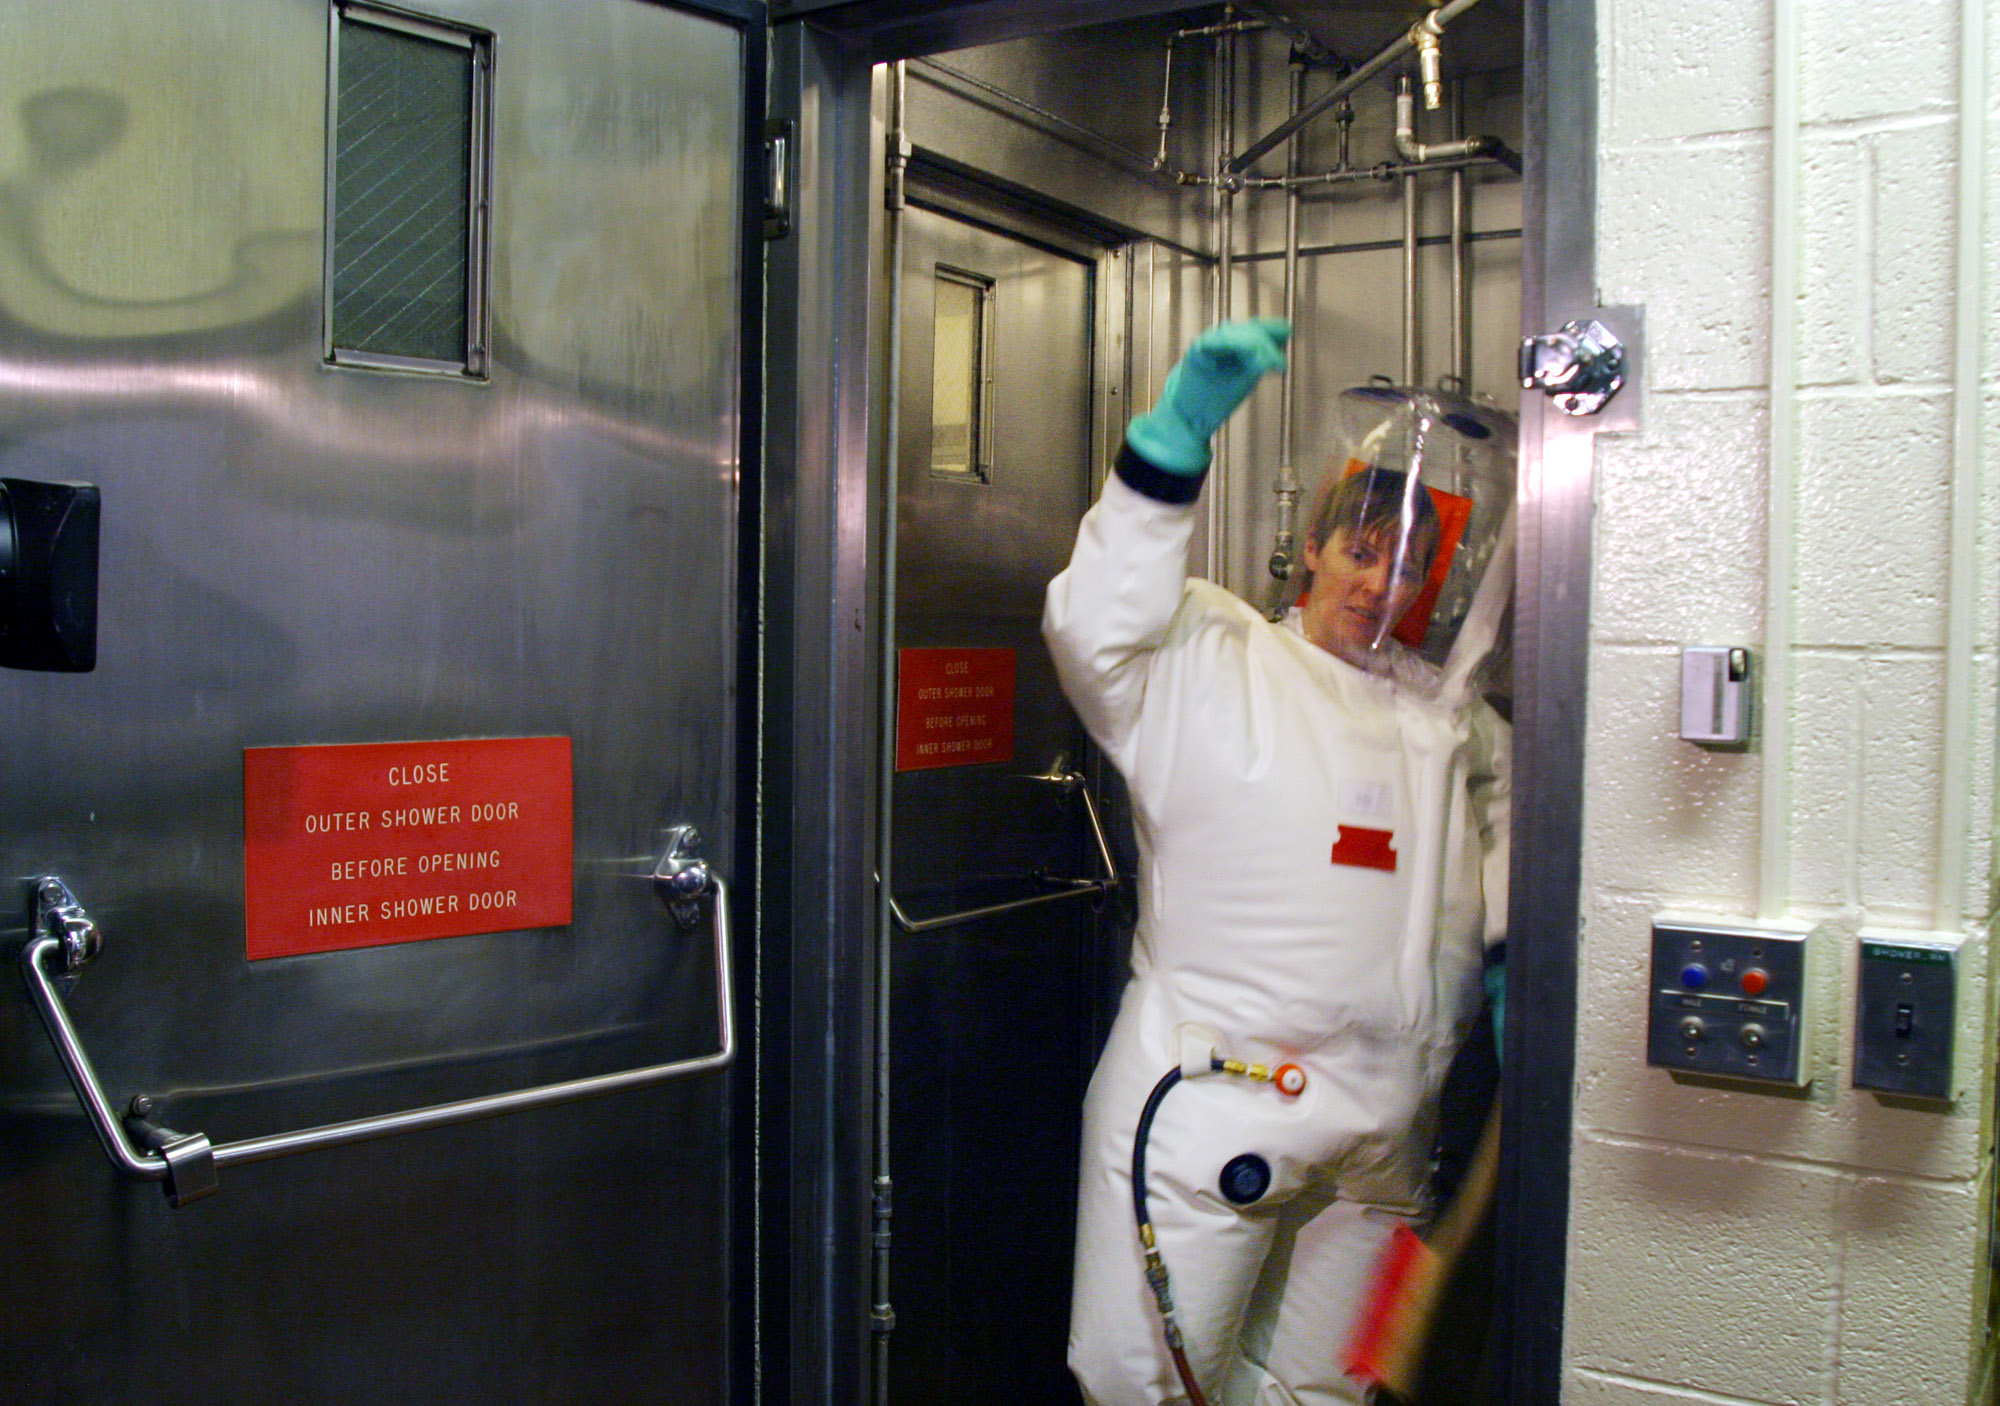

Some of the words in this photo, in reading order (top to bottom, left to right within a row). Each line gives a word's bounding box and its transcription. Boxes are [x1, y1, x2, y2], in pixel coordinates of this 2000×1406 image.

[945, 661, 969, 675] CLOSE
[918, 687, 942, 700] OUTER
[944, 686, 973, 699] SHOWER
[975, 686, 994, 698] DOOR
[925, 716, 953, 729] BEFORE
[956, 714, 987, 728] OPENING
[916, 742, 939, 755] INNER
[941, 740, 971, 753] SHOWER
[973, 738, 993, 751] DOOR
[388, 762, 450, 786] CLOSE
[305, 811, 371, 833] OUTER
[380, 805, 462, 828] SHOWER
[471, 802, 519, 823] DOOR
[331, 856, 408, 881] BEFORE
[418, 850, 501, 874] OPENING
[309, 903, 370, 927] INNER
[380, 895, 459, 920] SHOWER
[469, 889, 517, 911] DOOR
